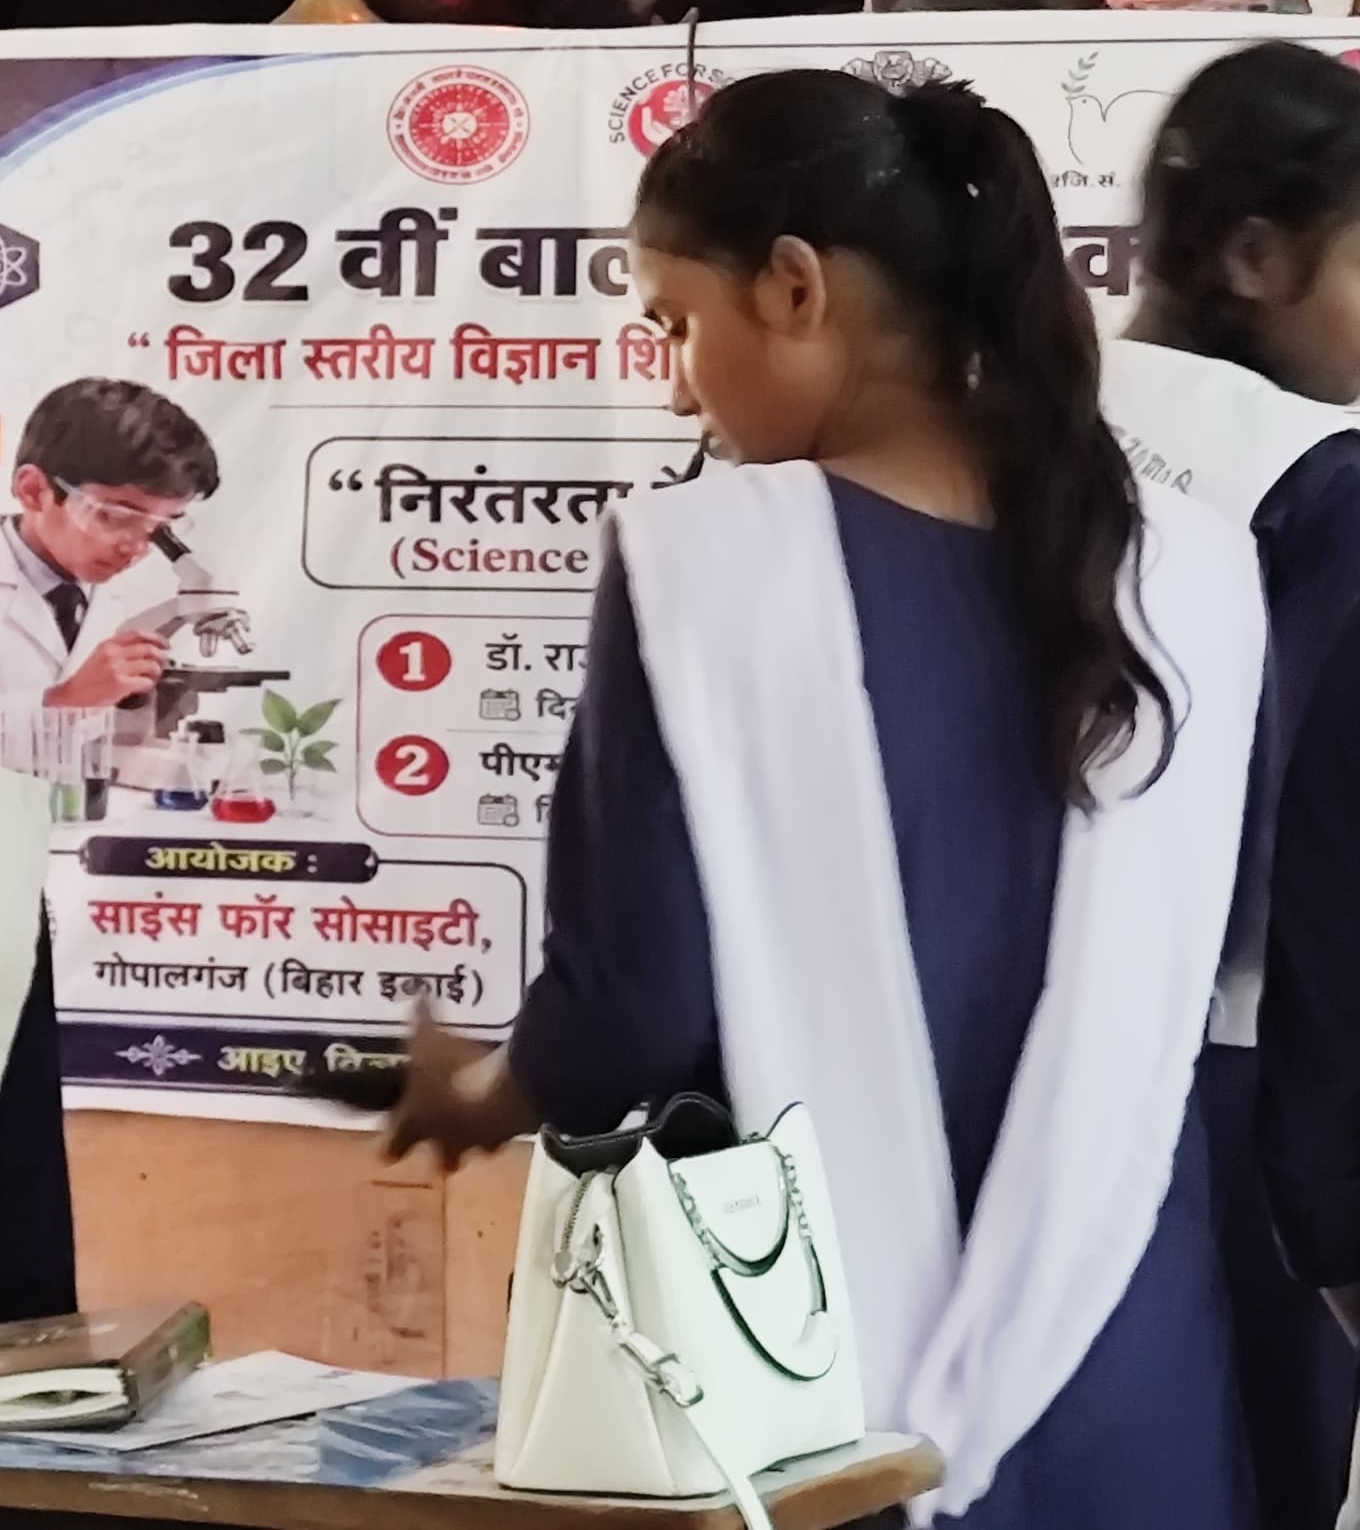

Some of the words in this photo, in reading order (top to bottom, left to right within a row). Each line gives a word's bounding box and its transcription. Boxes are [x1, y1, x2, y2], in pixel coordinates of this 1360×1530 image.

[608, 67, 659, 144] SCIENCE
[167, 220, 309, 302] 32
[335, 206, 458, 298] वीं
[165, 324, 285, 381] जिला
[301, 323, 436, 382] स्तरीय
[449, 323, 603, 386] विज्ञान
[389, 536, 590, 580] (Science
[398, 641, 427, 682] 1
[485, 632, 533, 672] डॉ.
[394, 743, 430, 787] 2
[145, 844, 298, 873] आयोजक
[88, 890, 202, 938] साइंस
[218, 894, 296, 941] फॉर
[93, 951, 249, 992] गोपालगंज
